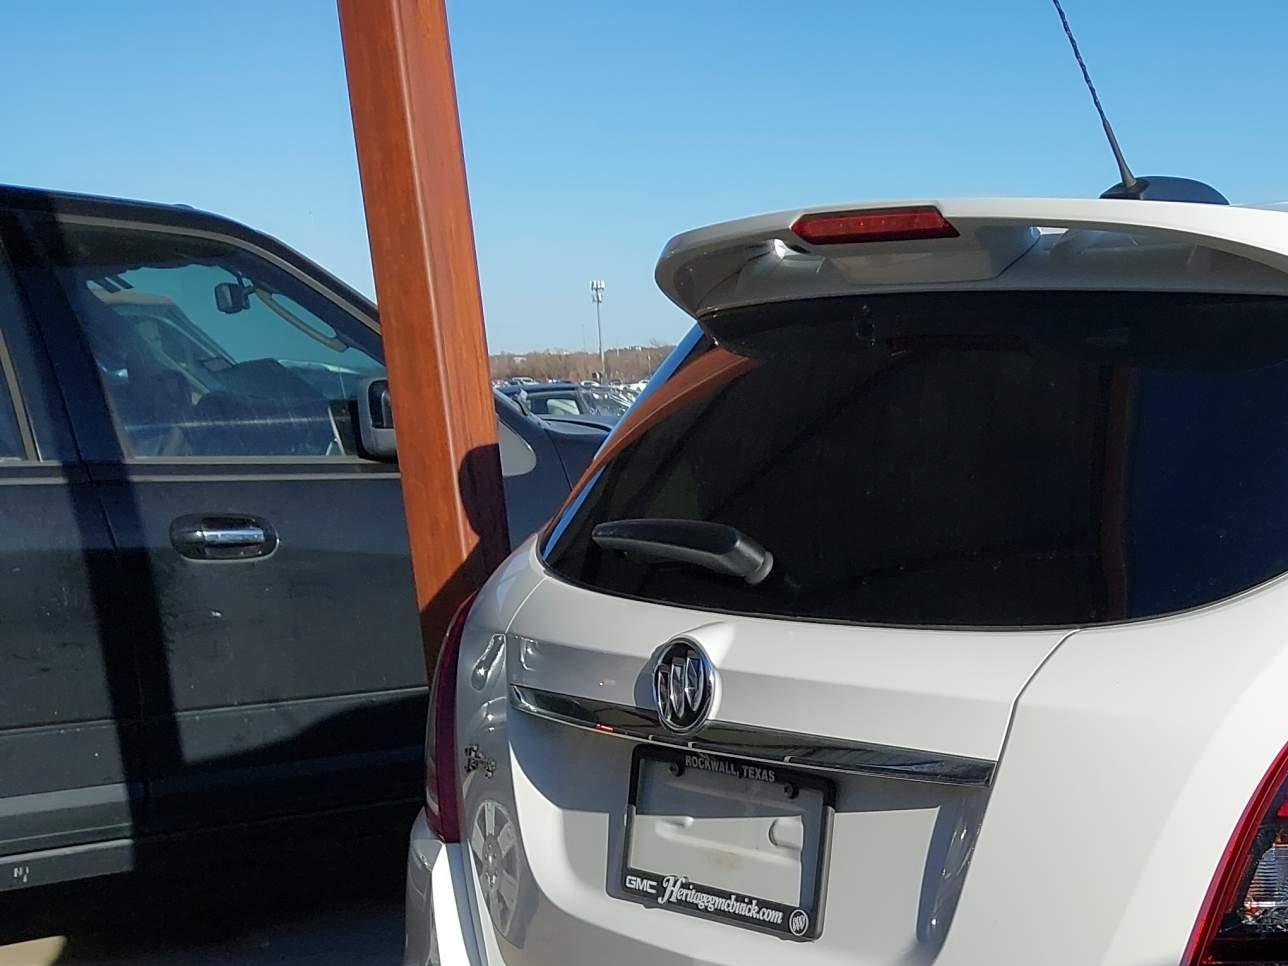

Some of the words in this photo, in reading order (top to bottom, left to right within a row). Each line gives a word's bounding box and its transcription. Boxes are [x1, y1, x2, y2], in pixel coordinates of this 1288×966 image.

[685, 755, 740, 777] ROCKWALL,
[743, 767, 776, 783] TEXAS
[625, 875, 658, 894] GMC
[657, 875, 783, 924] Heritagegmcbuick.com
